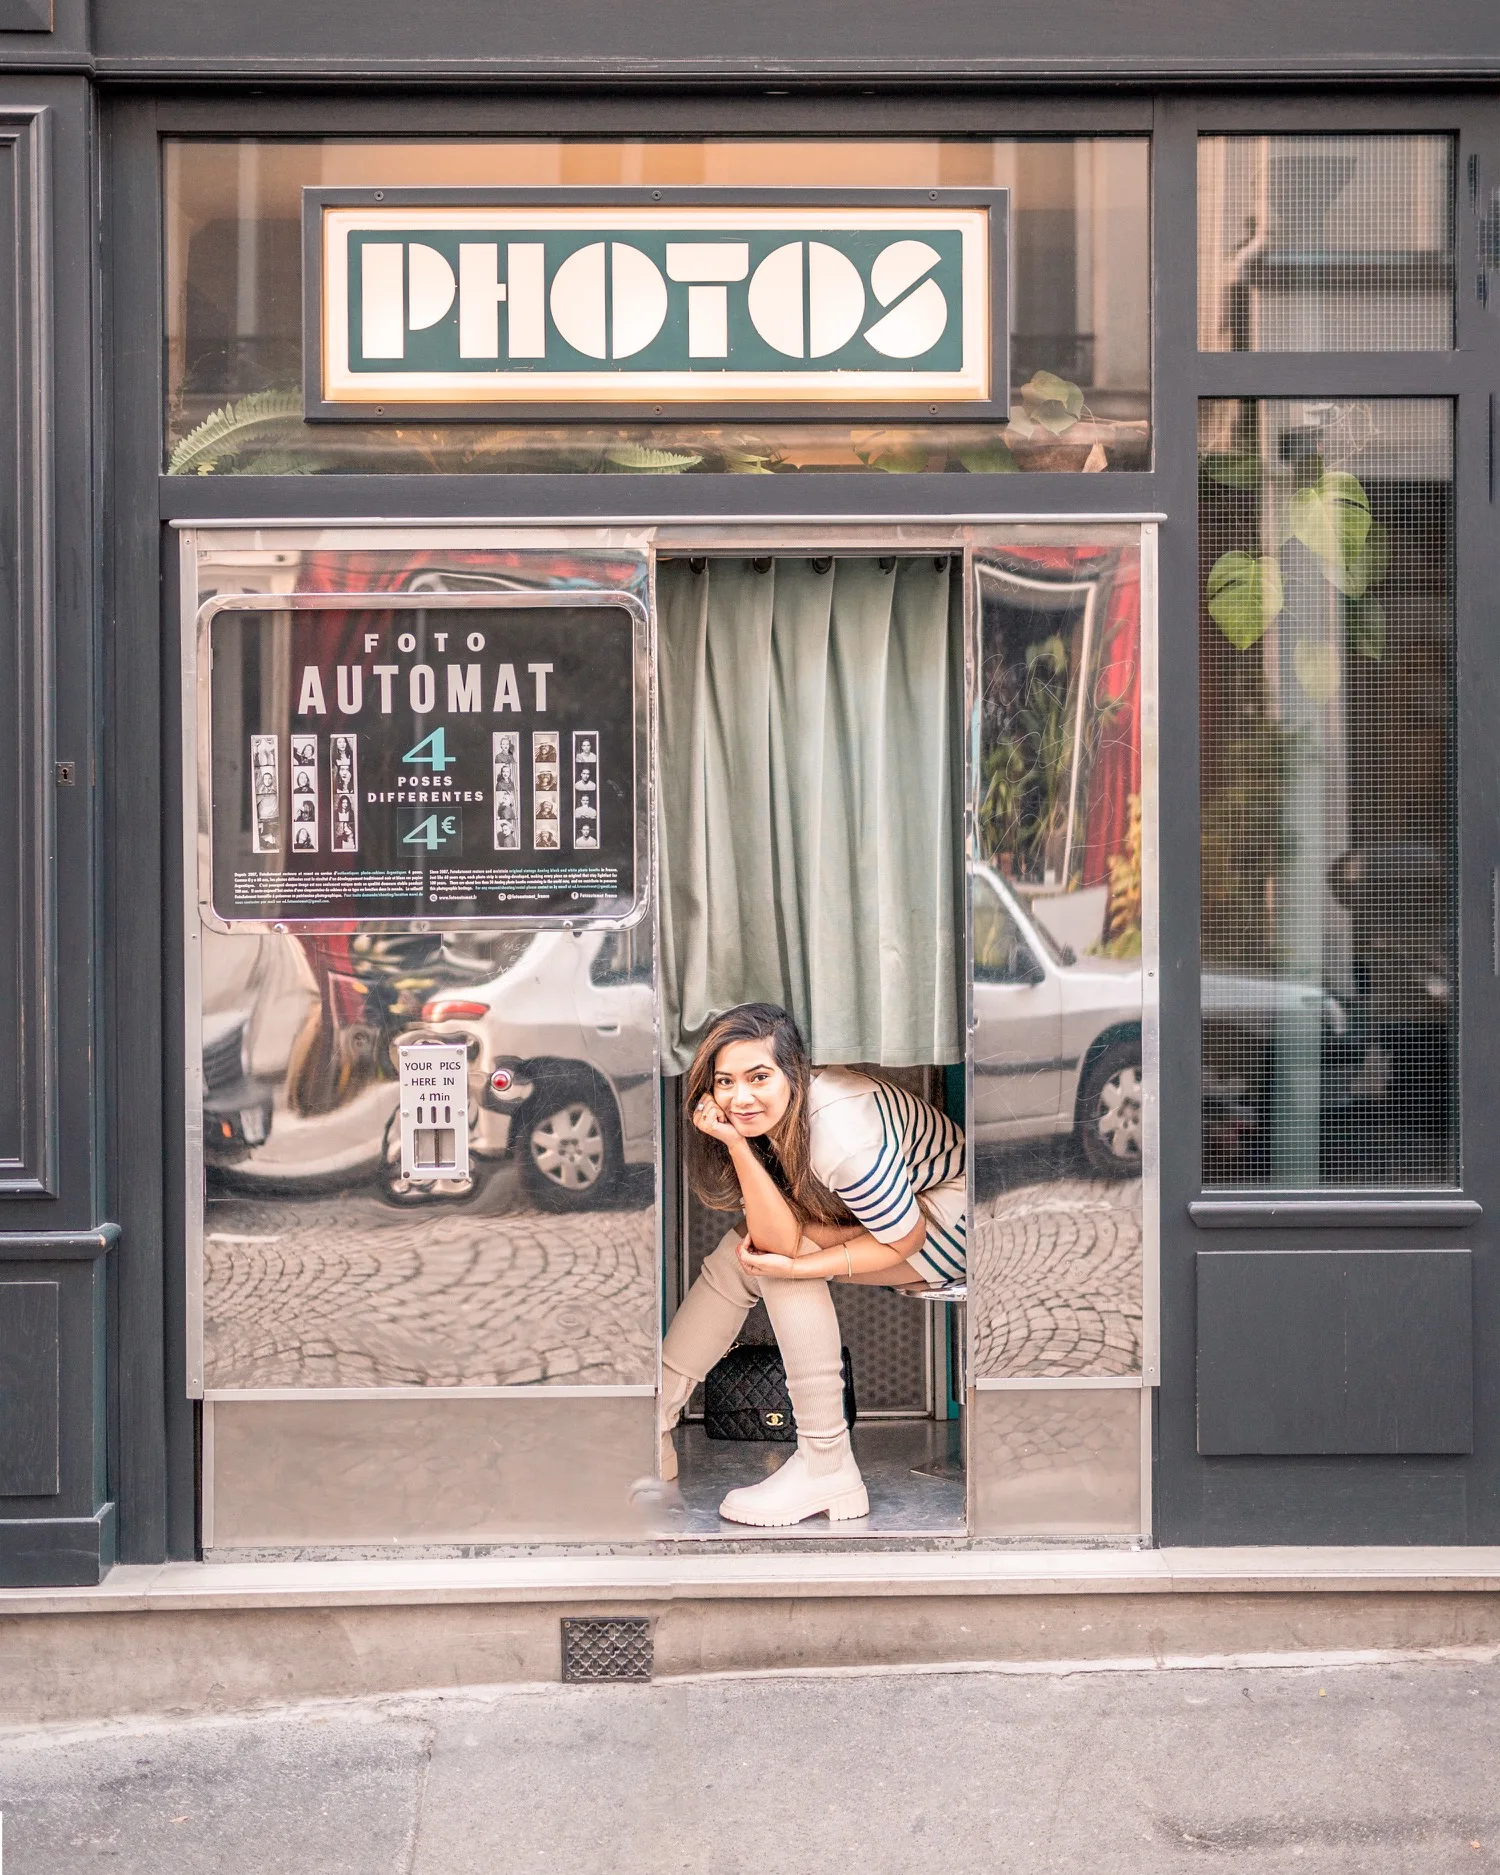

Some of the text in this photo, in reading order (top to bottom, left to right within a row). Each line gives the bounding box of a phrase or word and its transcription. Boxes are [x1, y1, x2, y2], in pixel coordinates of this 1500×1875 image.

[361, 240, 948, 360] PHOTOS
[364, 632, 486, 653] FOTO
[298, 663, 554, 715] AUTOMAT
[402, 727, 456, 771] 4
[397, 776, 453, 787] POSES
[367, 791, 484, 803] DIFFERENTES
[405, 1062, 461, 1071] YOUR PICS
[412, 1077, 455, 1086] HERE IN
[420, 1092, 450, 1101] 4 min
